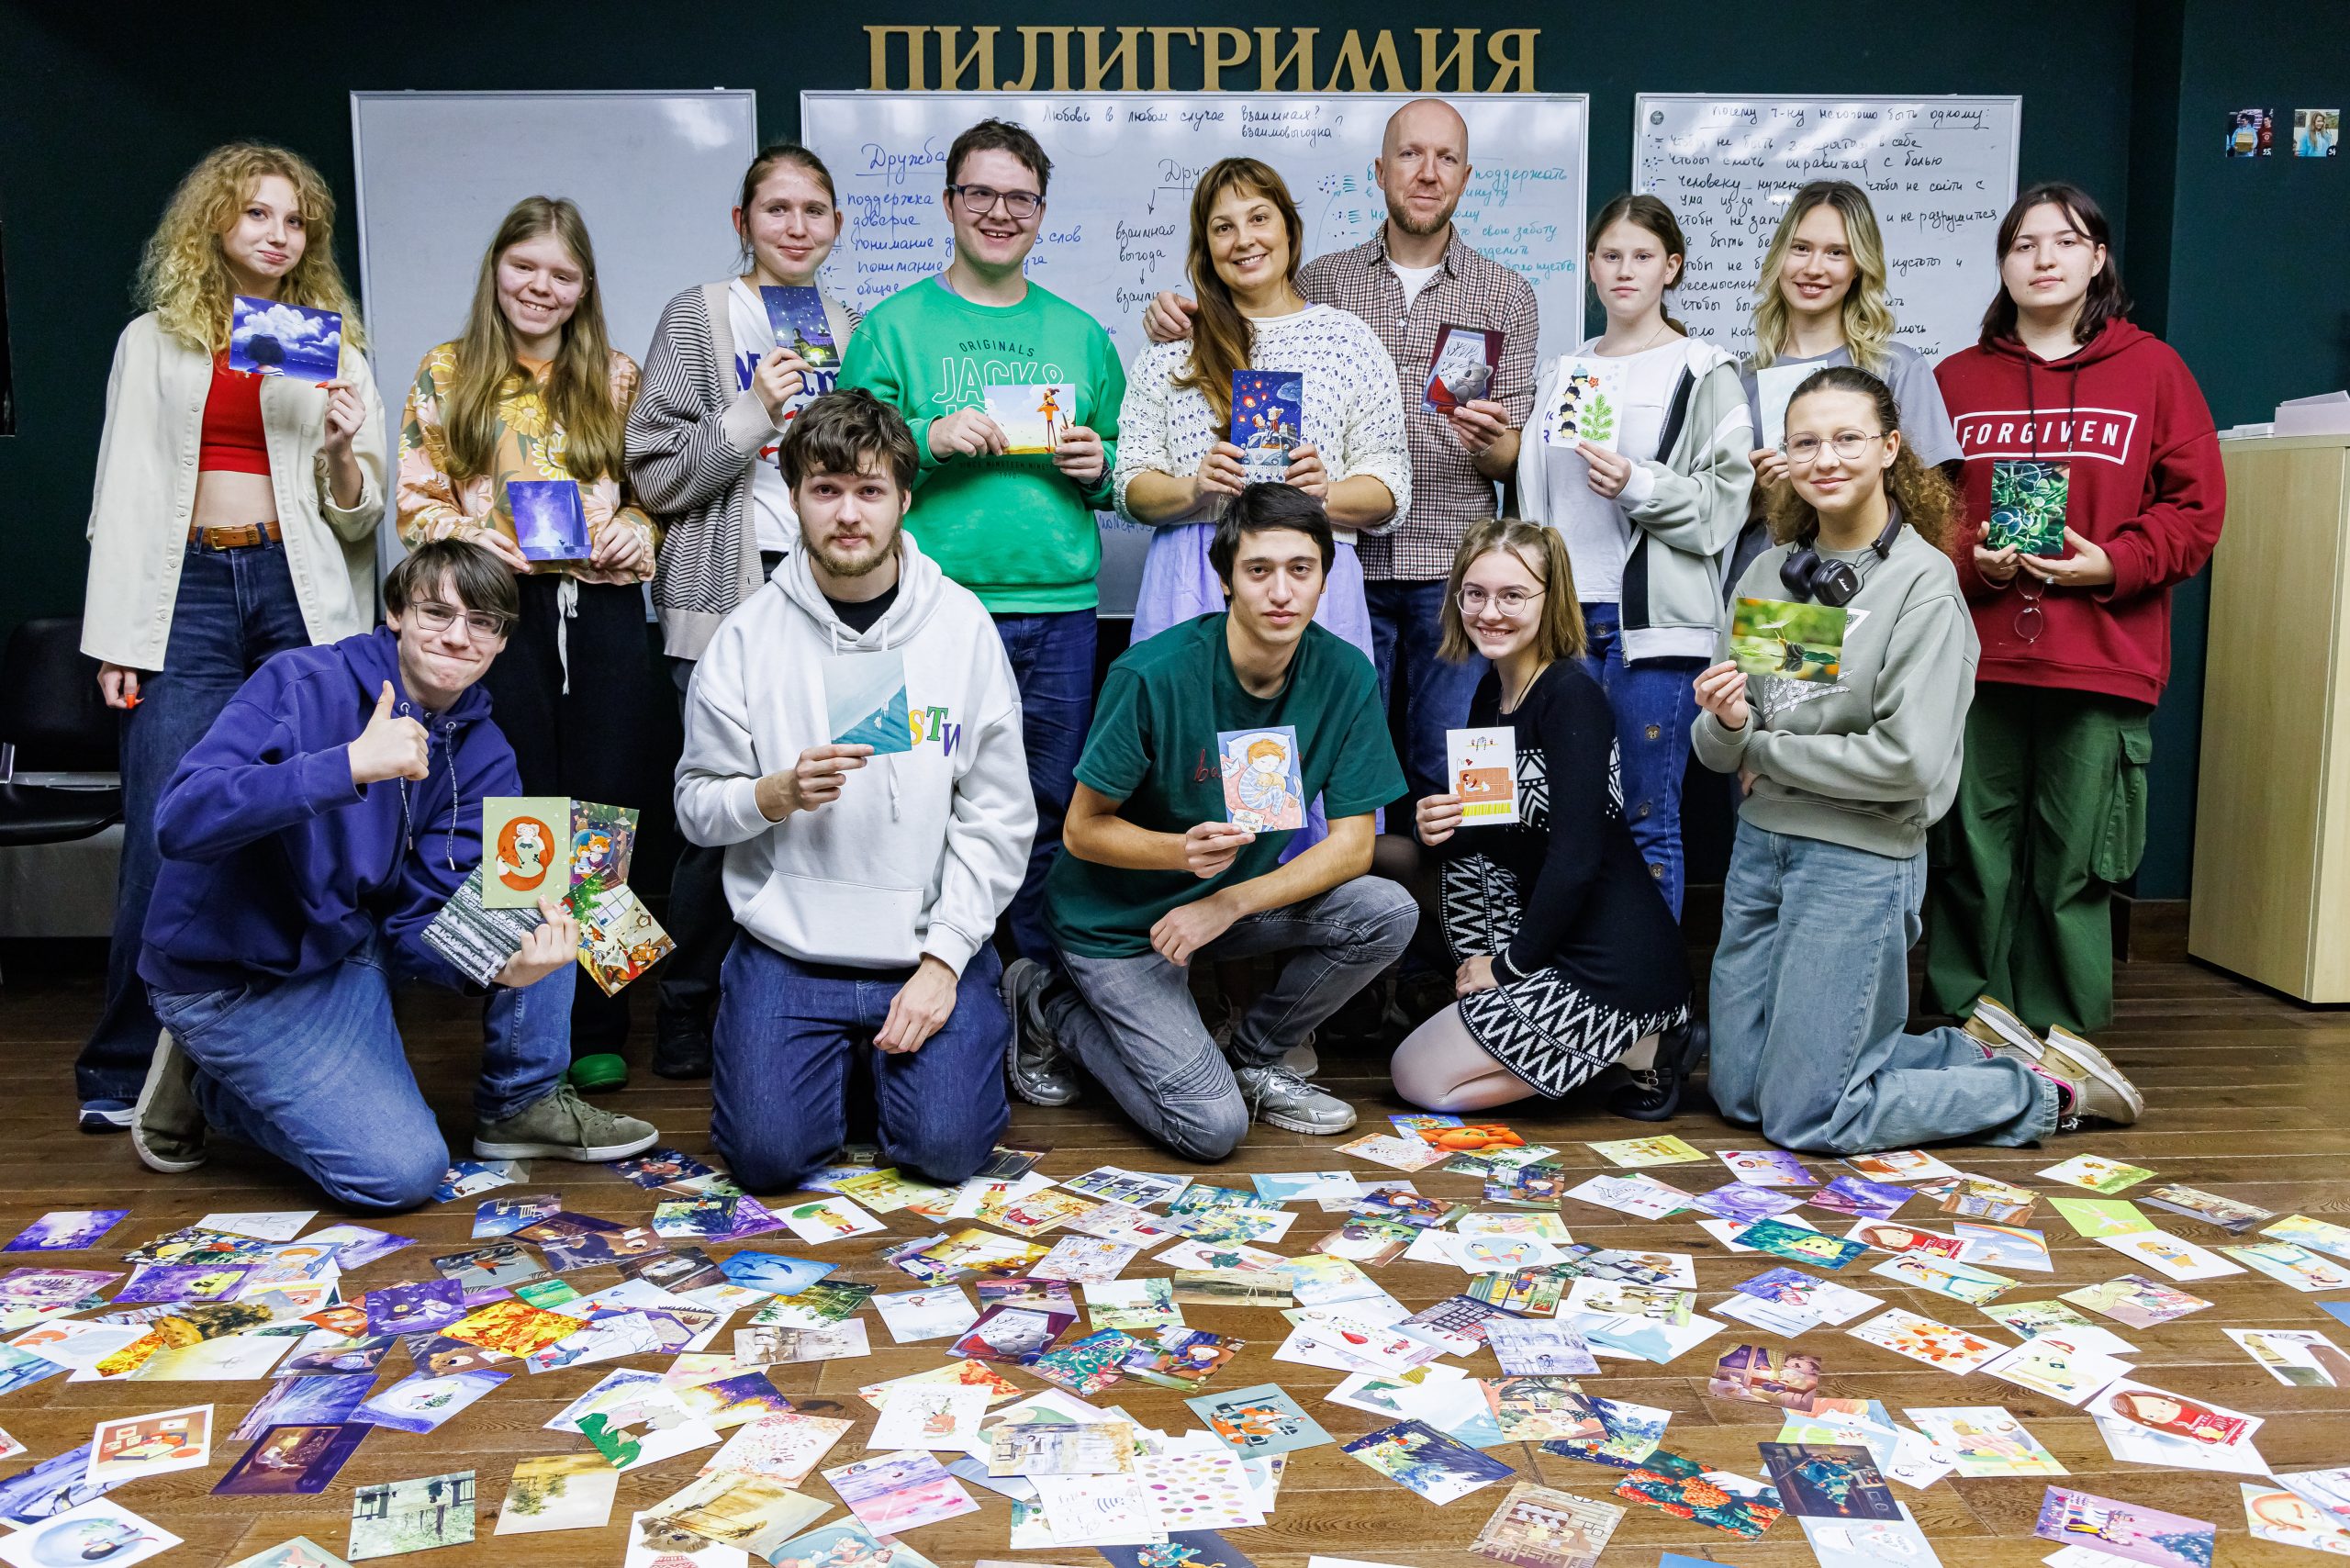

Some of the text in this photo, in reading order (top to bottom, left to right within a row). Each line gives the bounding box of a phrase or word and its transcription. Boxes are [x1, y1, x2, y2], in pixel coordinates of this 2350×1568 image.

[863, 25, 1541, 91] ПИЛИГРИМИЯ
[1042, 105, 1091, 123] Любовь
[1104, 106, 1113, 122] в
[1127, 107, 1169, 123] любом
[1179, 110, 1225, 132] случае
[1717, 138, 1732, 147] не
[861, 136, 947, 187] Дружба
[1905, 150, 1943, 166] болью
[1475, 167, 1567, 192] поддержать
[1865, 177, 1898, 192] чтобы
[1906, 182, 1919, 192] не
[846, 191, 935, 220] поддержка
[1462, 187, 1508, 207] инуту
[1680, 194, 1703, 207] ума
[1371, 208, 1386, 221] не
[1729, 217, 1743, 227] не
[1900, 212, 1914, 222] не
[854, 236, 934, 252] понимание
[1049, 226, 1081, 243] слов
[1115, 220, 1176, 249] взаимная
[1482, 224, 1510, 237] свою
[1513, 220, 1558, 242] заботу
[1119, 247, 1167, 273] выгода
[1476, 245, 1528, 262] азделить
[857, 261, 943, 274] понимание
[1684, 255, 1713, 272] тобы
[1728, 262, 1743, 272] не
[1679, 276, 1757, 292] бессмыслен
[1681, 296, 1721, 311] чтобы
[1897, 324, 1927, 334] мочь
[958, 339, 1035, 357] ORIGINALS
[1961, 420, 2120, 449] FORGIVEN
